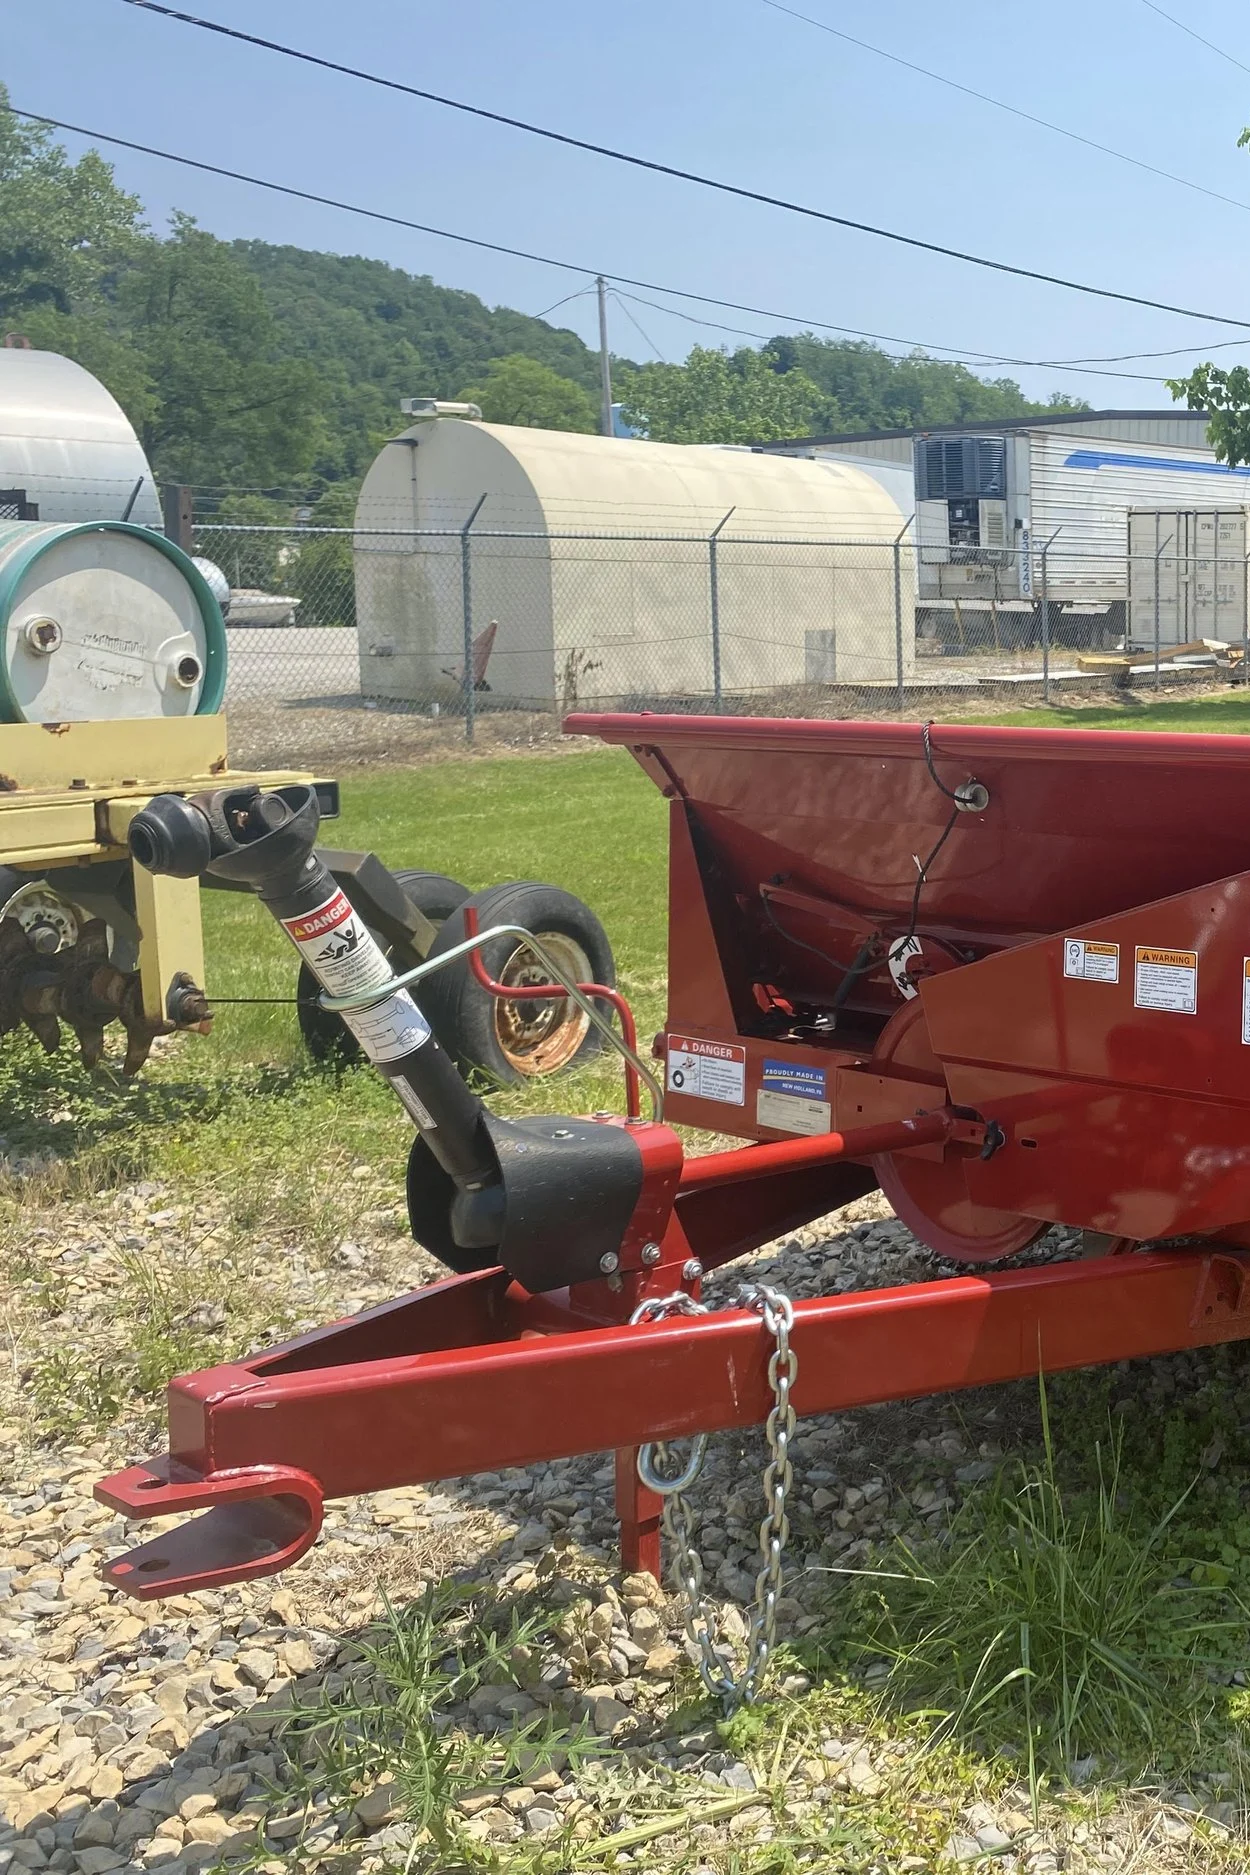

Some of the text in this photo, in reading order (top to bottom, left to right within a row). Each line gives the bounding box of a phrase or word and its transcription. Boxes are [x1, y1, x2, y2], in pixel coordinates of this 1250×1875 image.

[1022, 530, 1031, 593] 833240
[302, 897, 350, 934] DANGER
[1092, 945, 1116, 954] WARNING
[1151, 953, 1190, 965] WARNING
[692, 1042, 733, 1059] DANGER
[765, 1068, 794, 1076] PROUDLY
[795, 1071, 813, 1079] MADE
